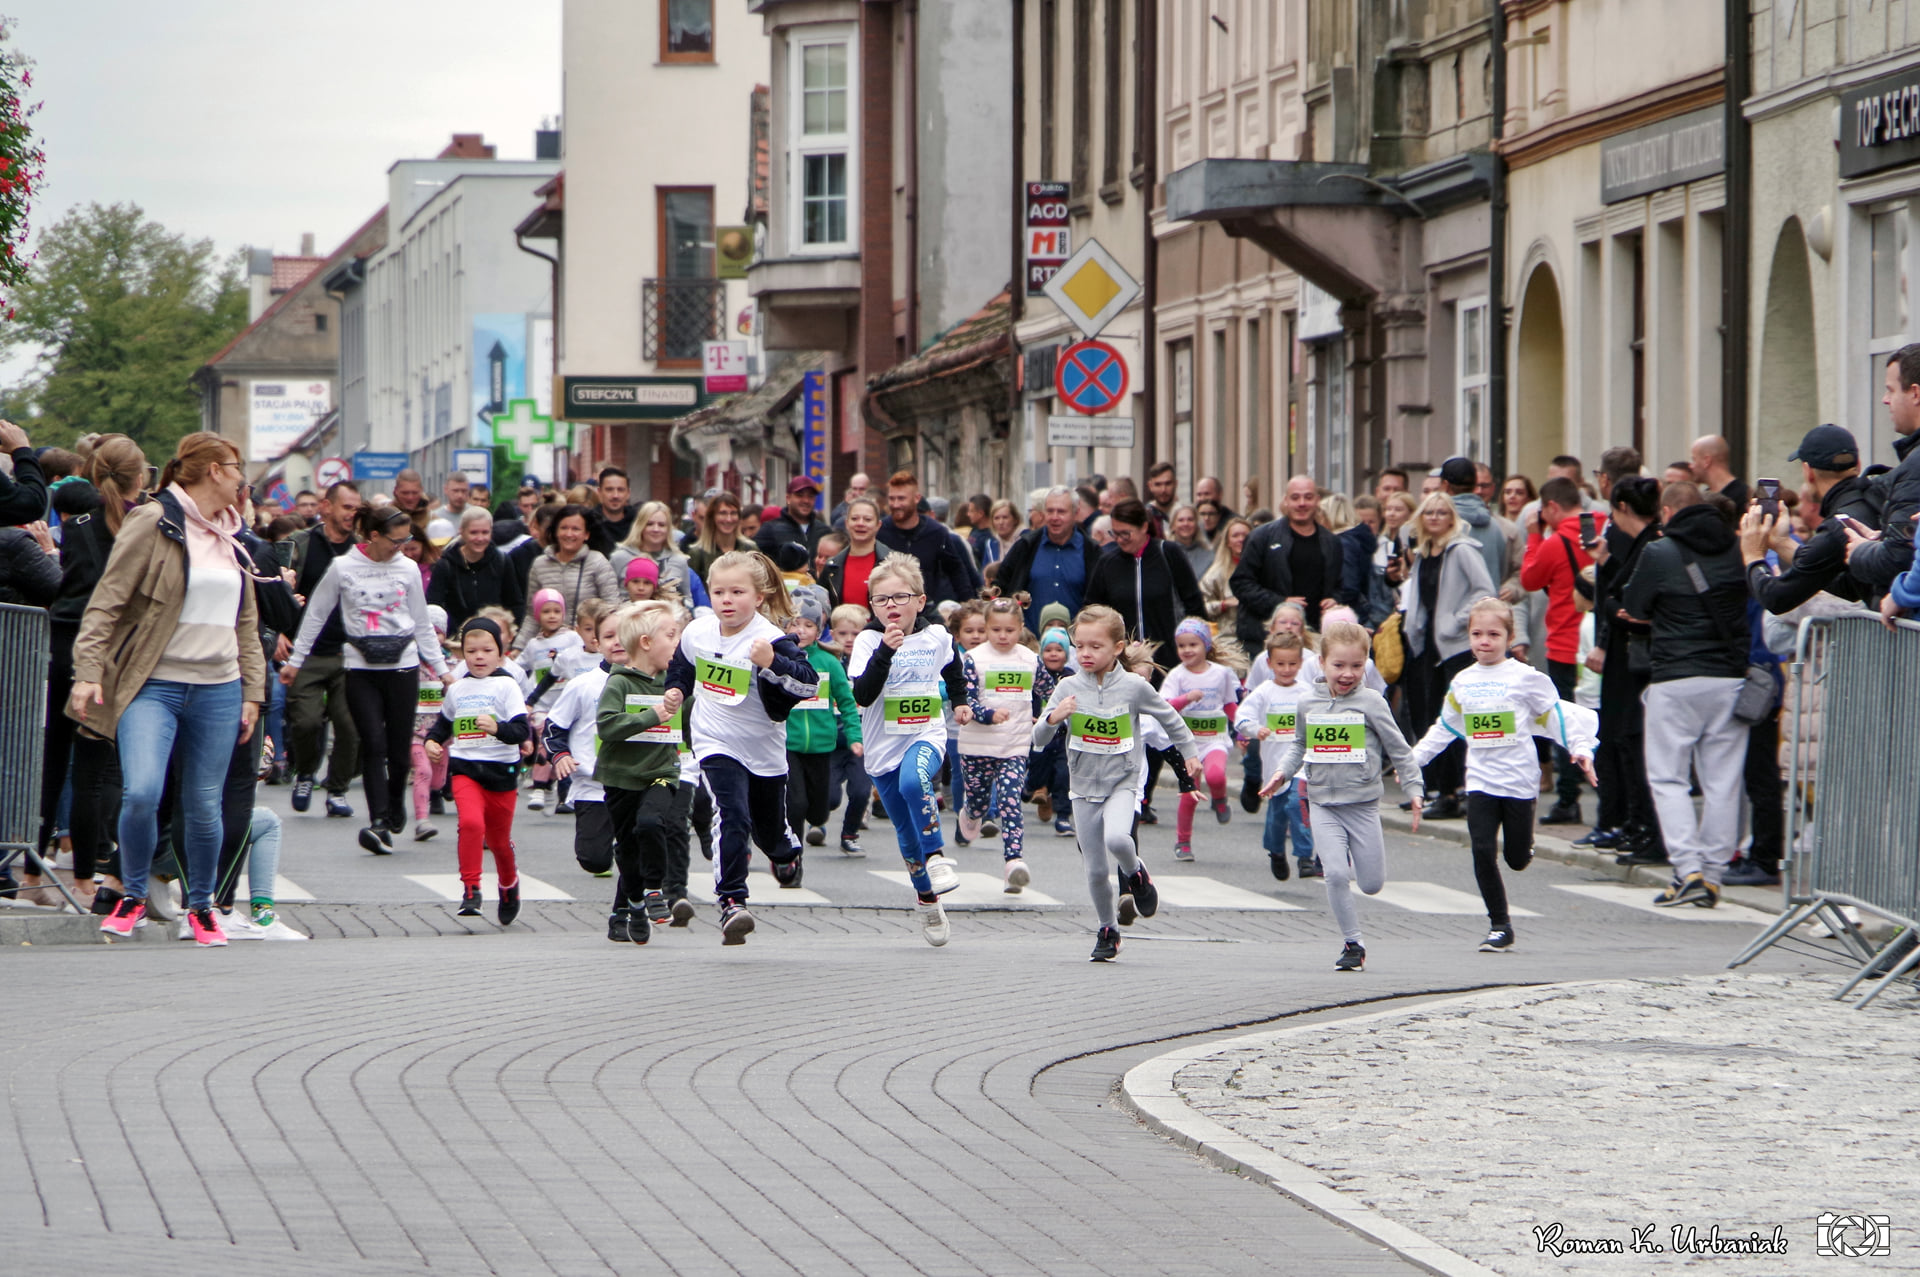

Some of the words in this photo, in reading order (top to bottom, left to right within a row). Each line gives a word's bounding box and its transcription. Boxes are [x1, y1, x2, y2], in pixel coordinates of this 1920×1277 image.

[1856, 95, 1880, 149] TOP
[1883, 83, 1920, 142] SECR
[1029, 203, 1069, 219] AGD
[1032, 266, 1060, 283] RT
[577, 388, 635, 400] STEFCZYK
[706, 664, 733, 685] 771
[998, 673, 1022, 685] 537
[899, 698, 931, 714] 662
[1083, 718, 1119, 736] 483
[1191, 719, 1218, 730] 908
[1278, 715, 1296, 727] 48
[1472, 715, 1502, 730] 845
[1313, 727, 1351, 742] 484
